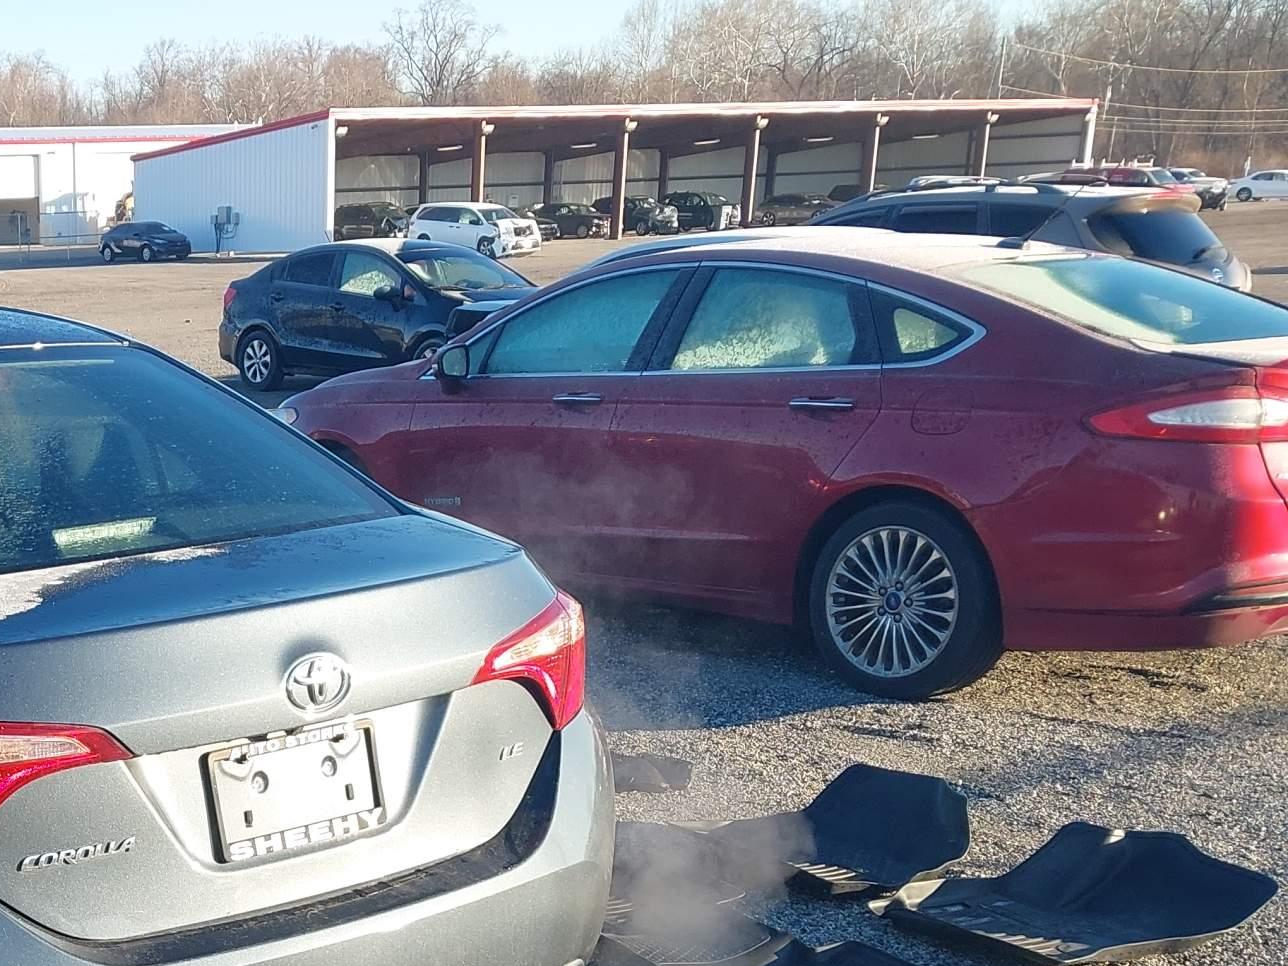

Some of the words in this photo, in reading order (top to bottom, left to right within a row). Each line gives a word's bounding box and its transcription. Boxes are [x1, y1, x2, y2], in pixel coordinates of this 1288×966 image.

[498, 741, 525, 761] LE
[229, 806, 385, 862] SHEEHY
[15, 836, 137, 873] COROLLA
